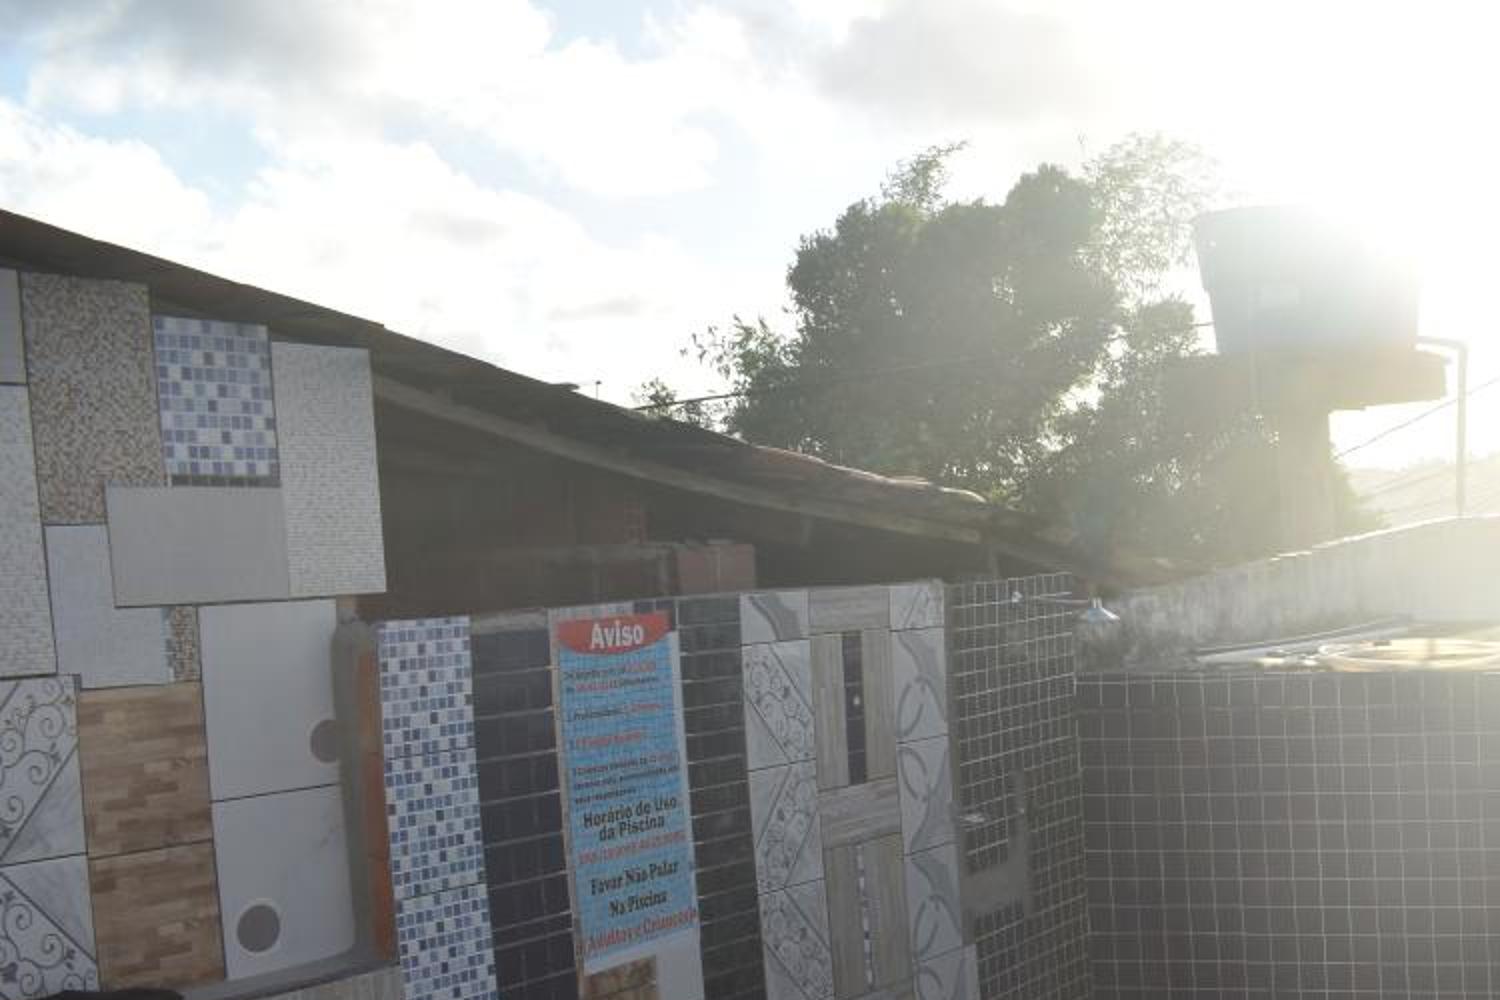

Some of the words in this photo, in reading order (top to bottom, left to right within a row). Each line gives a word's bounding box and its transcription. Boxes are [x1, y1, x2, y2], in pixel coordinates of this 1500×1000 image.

[591, 620, 645, 650] Aviso
[636, 800, 652, 815] de
[620, 816, 665, 837] Piscina
